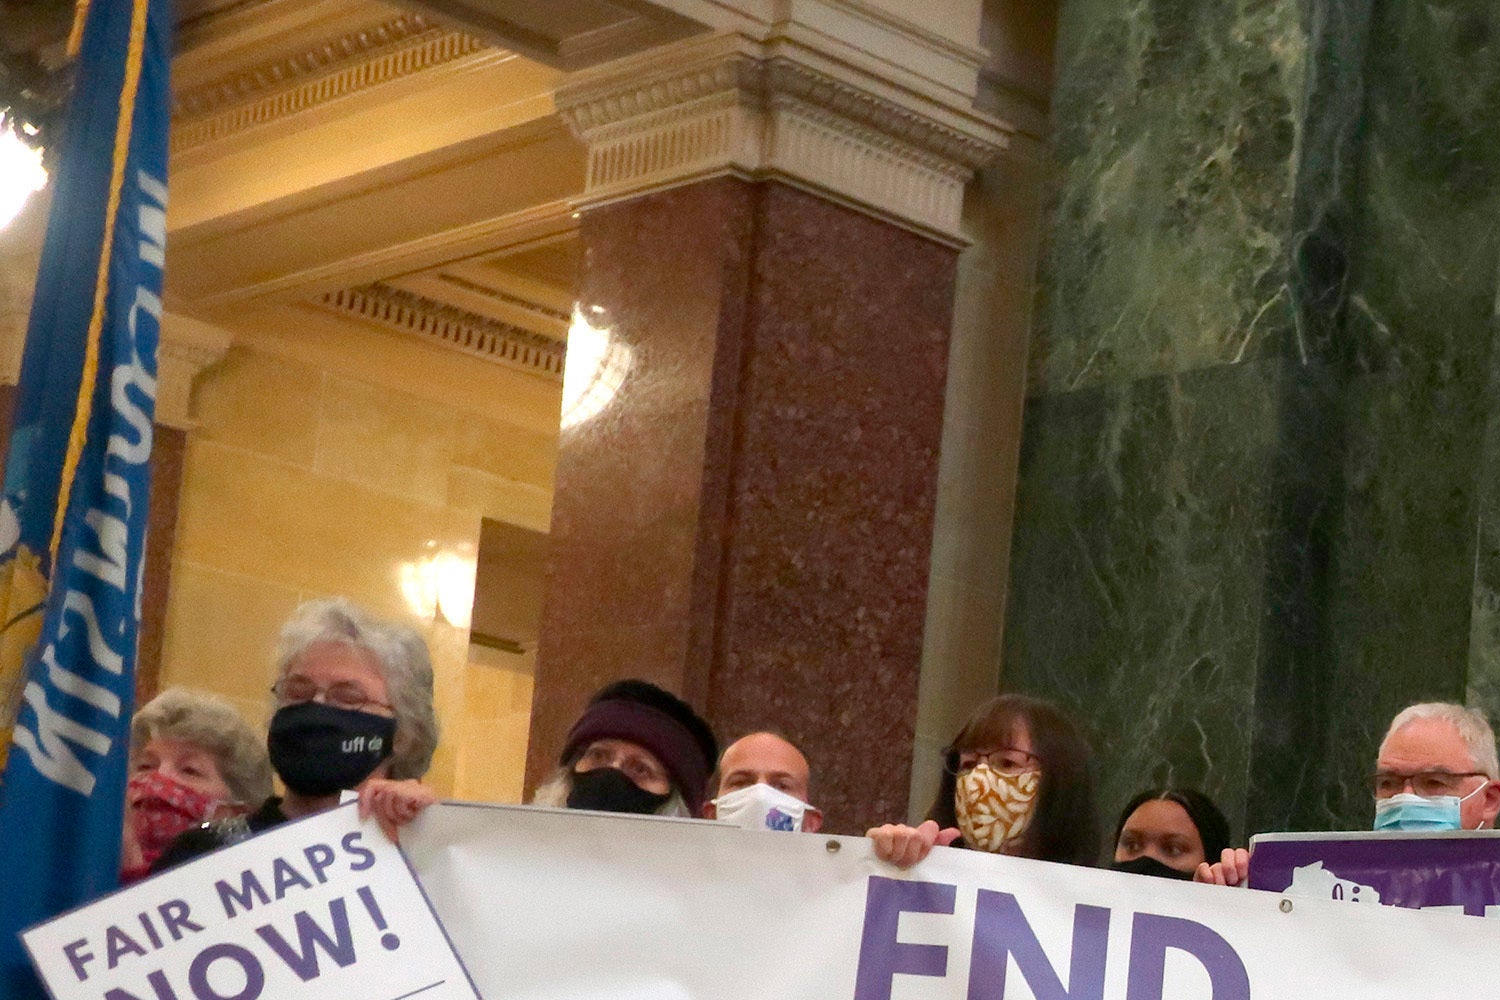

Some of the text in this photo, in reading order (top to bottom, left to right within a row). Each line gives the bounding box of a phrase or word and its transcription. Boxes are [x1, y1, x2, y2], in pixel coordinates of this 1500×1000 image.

[342, 737, 364, 752] uff
[63, 831, 376, 982] FAIR MAPS
